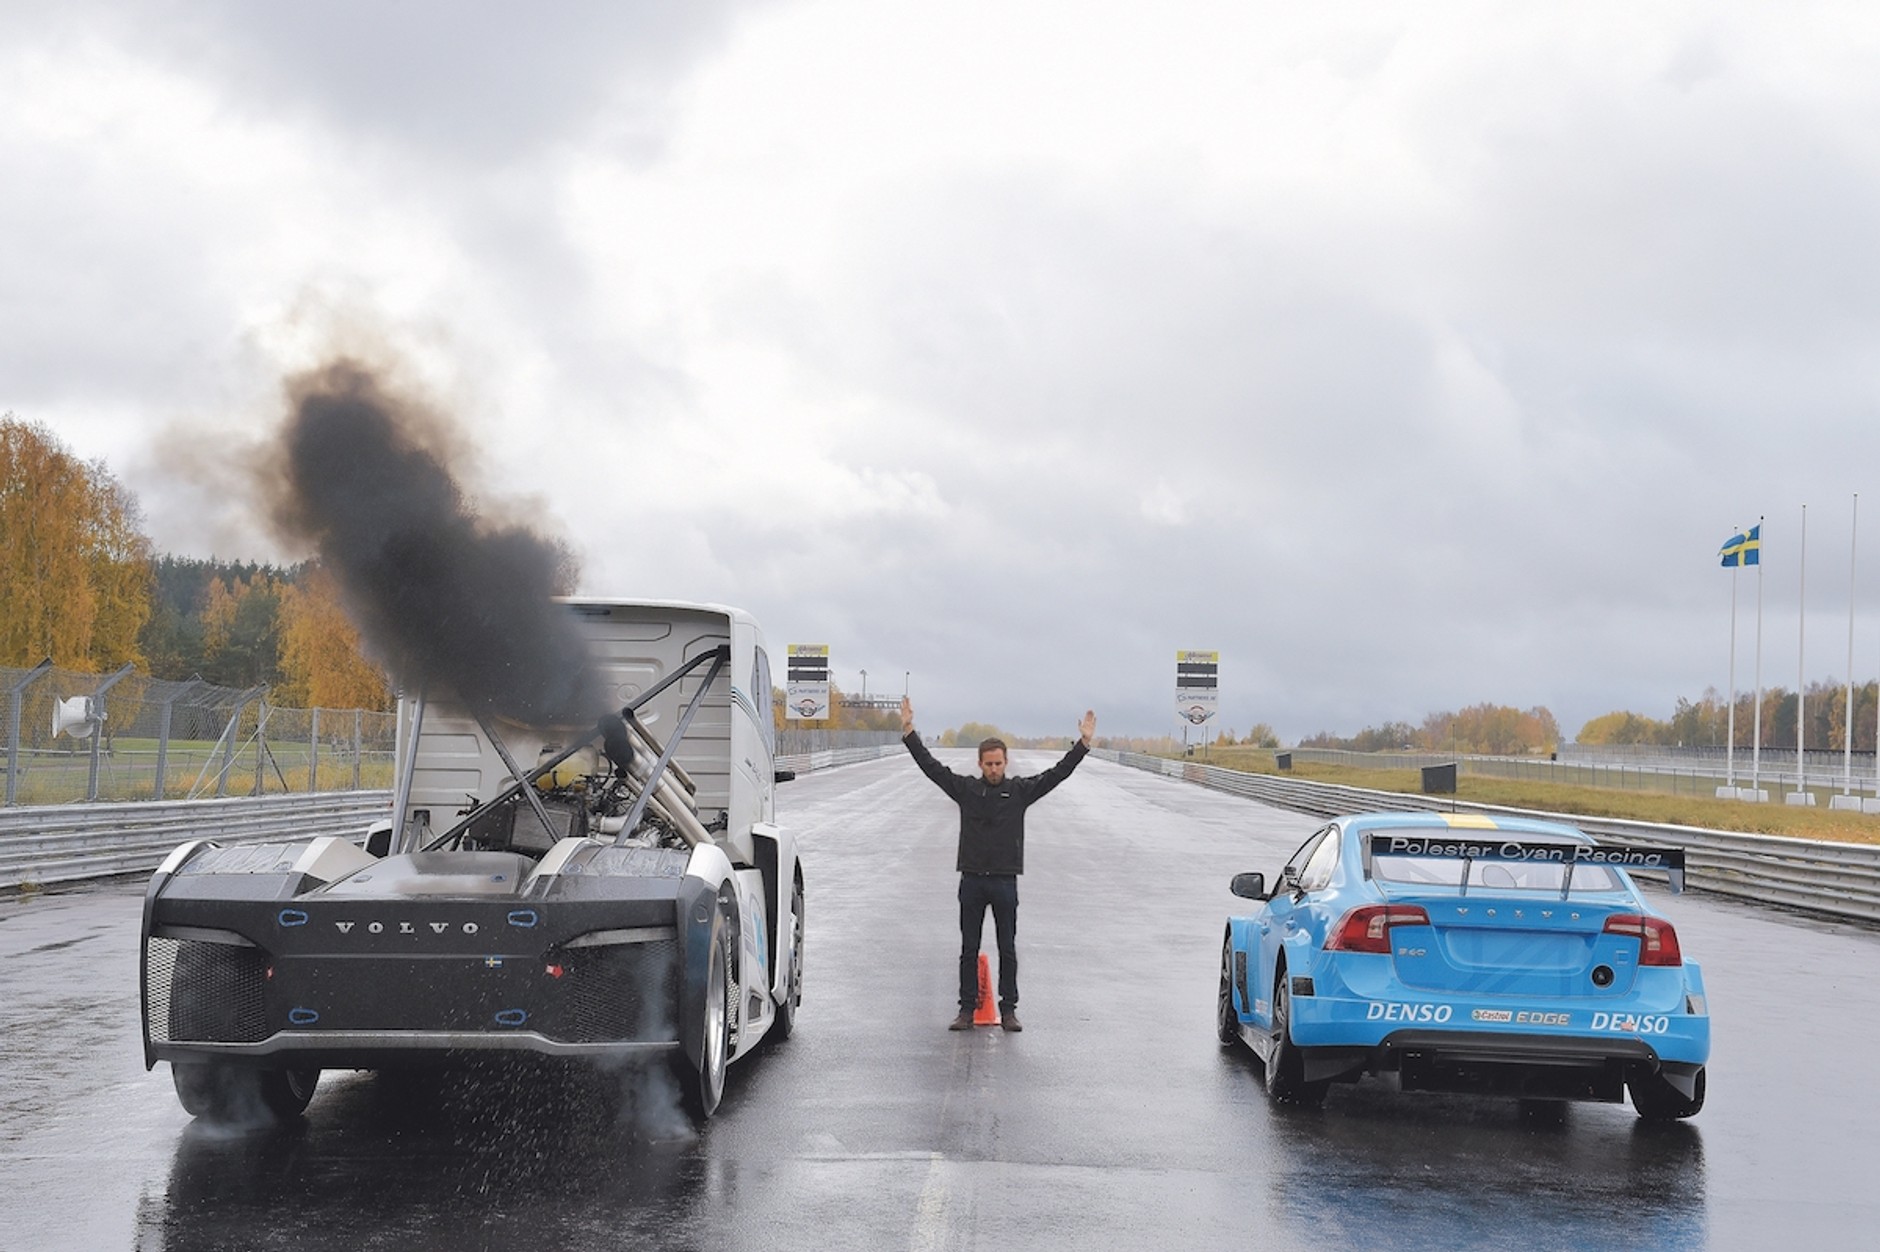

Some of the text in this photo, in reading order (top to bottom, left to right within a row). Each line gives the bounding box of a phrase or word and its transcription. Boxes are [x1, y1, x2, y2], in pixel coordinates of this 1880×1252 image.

[1389, 837, 1663, 867] Polestar Cyan Racing
[335, 921, 480, 935] VOLVO
[1366, 1002, 1454, 1023] DENSO
[1480, 1010, 1571, 1026] Castrol EDGE
[1591, 1012, 1670, 1034] DENSO
